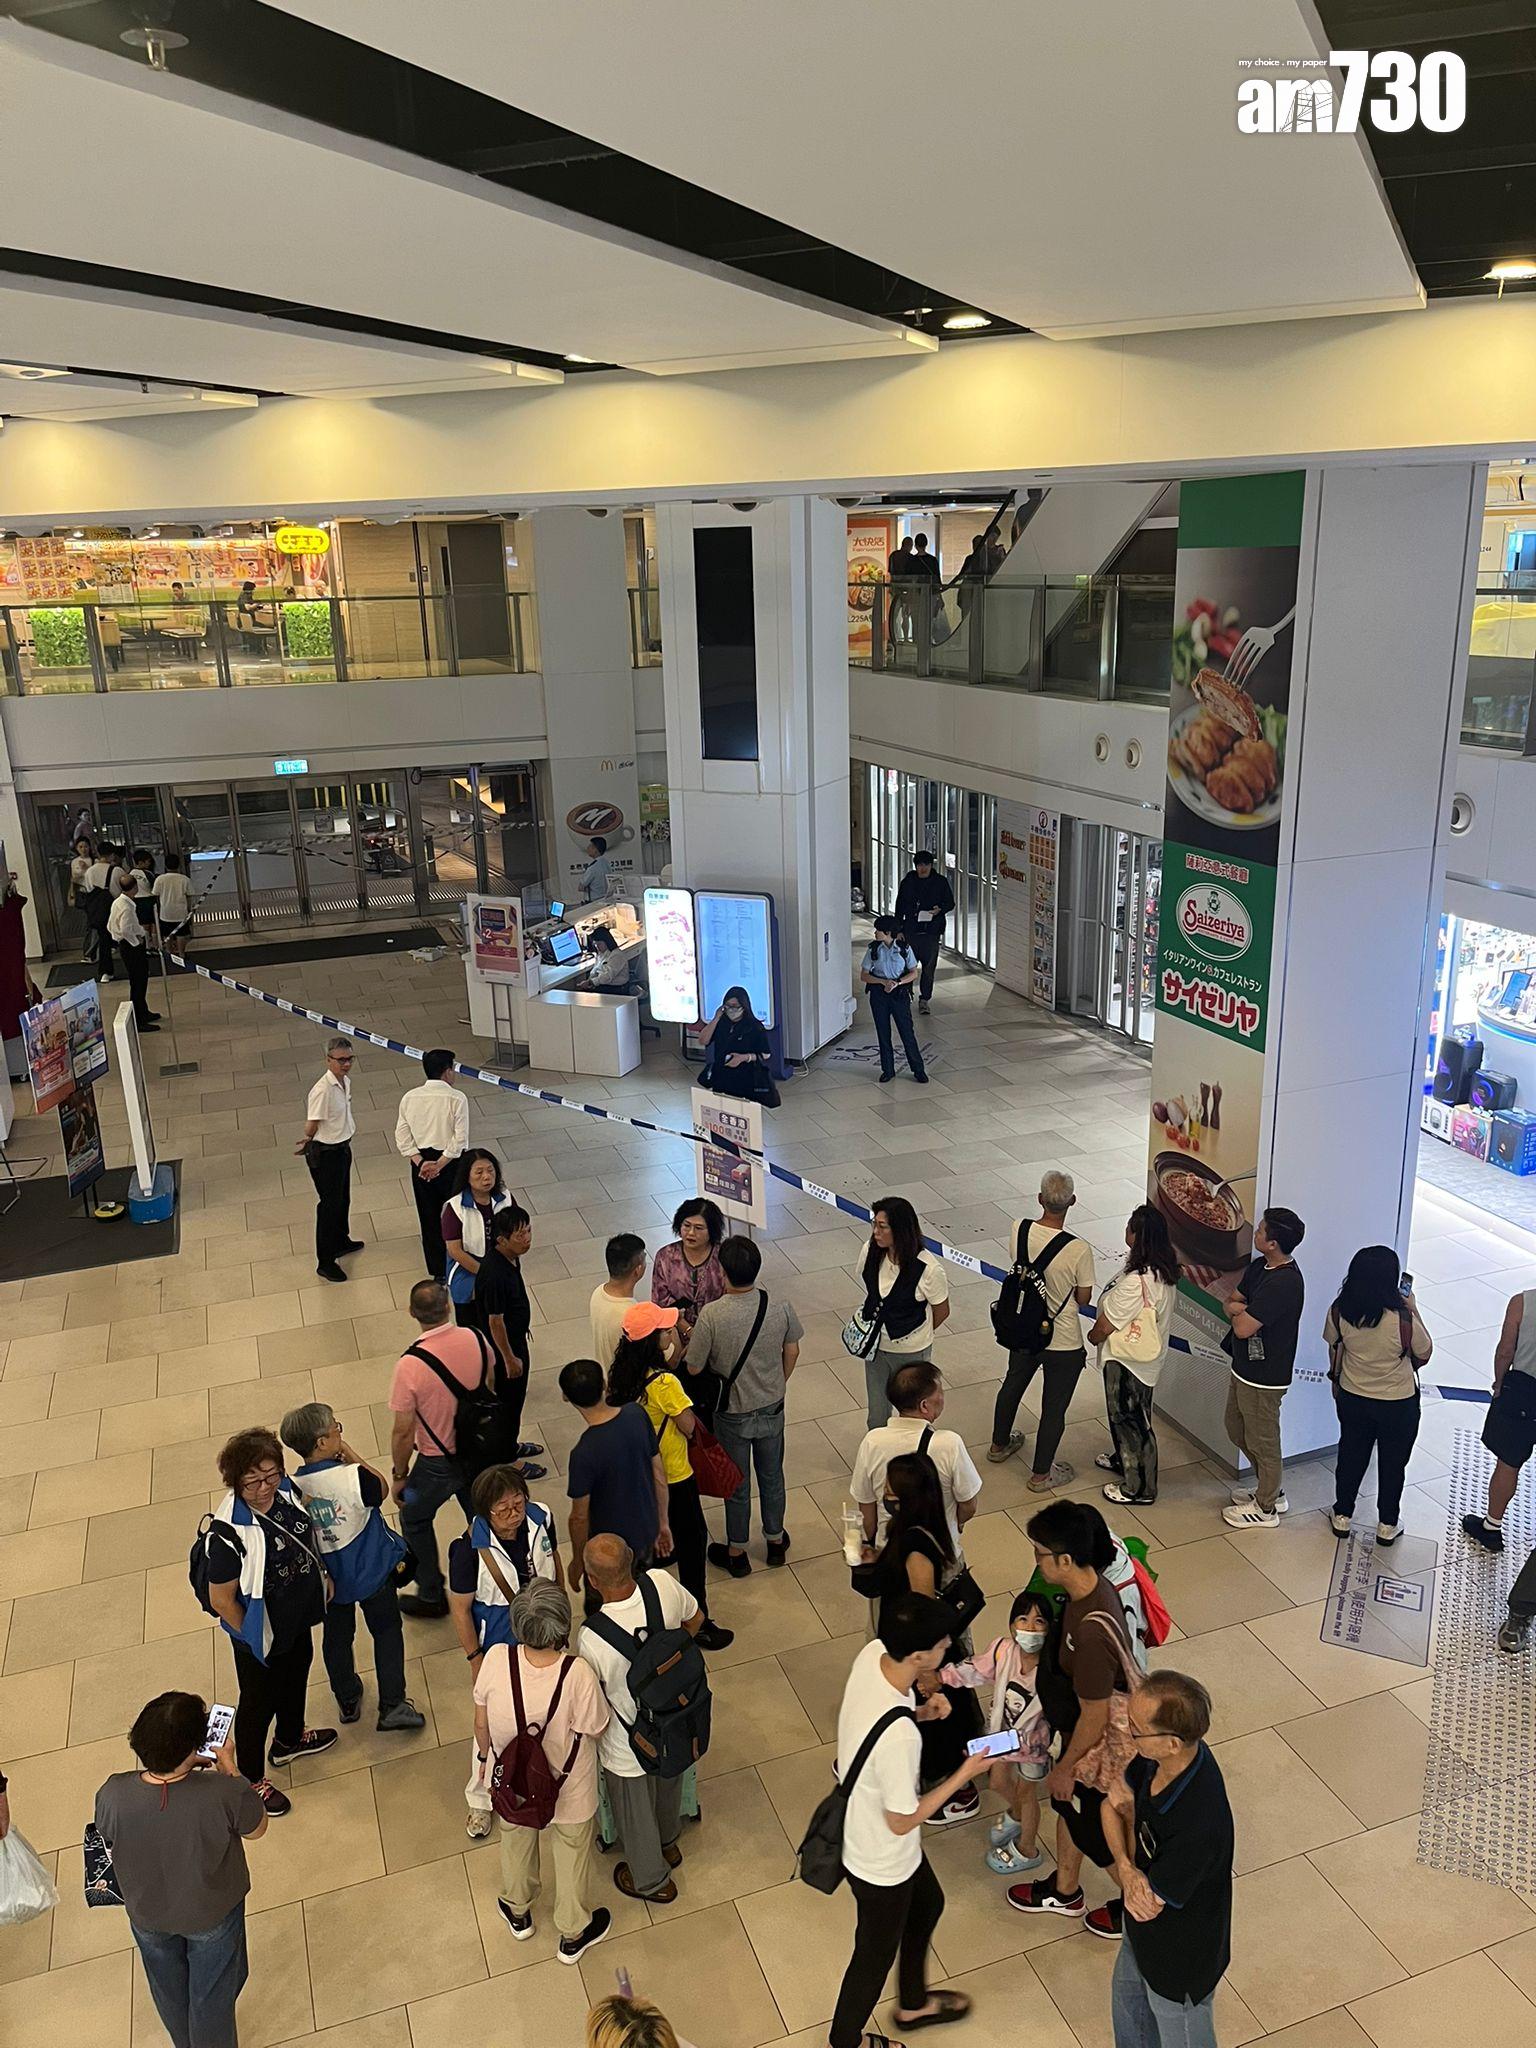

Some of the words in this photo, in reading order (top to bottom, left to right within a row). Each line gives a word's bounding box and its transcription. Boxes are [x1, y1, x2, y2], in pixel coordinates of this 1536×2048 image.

[1183, 899, 1246, 942] Saizeriya
[1162, 968, 1260, 1037] サイゼリヤ
[1178, 1299, 1201, 1319] SHOP
[1334, 1620, 1342, 1630] the
